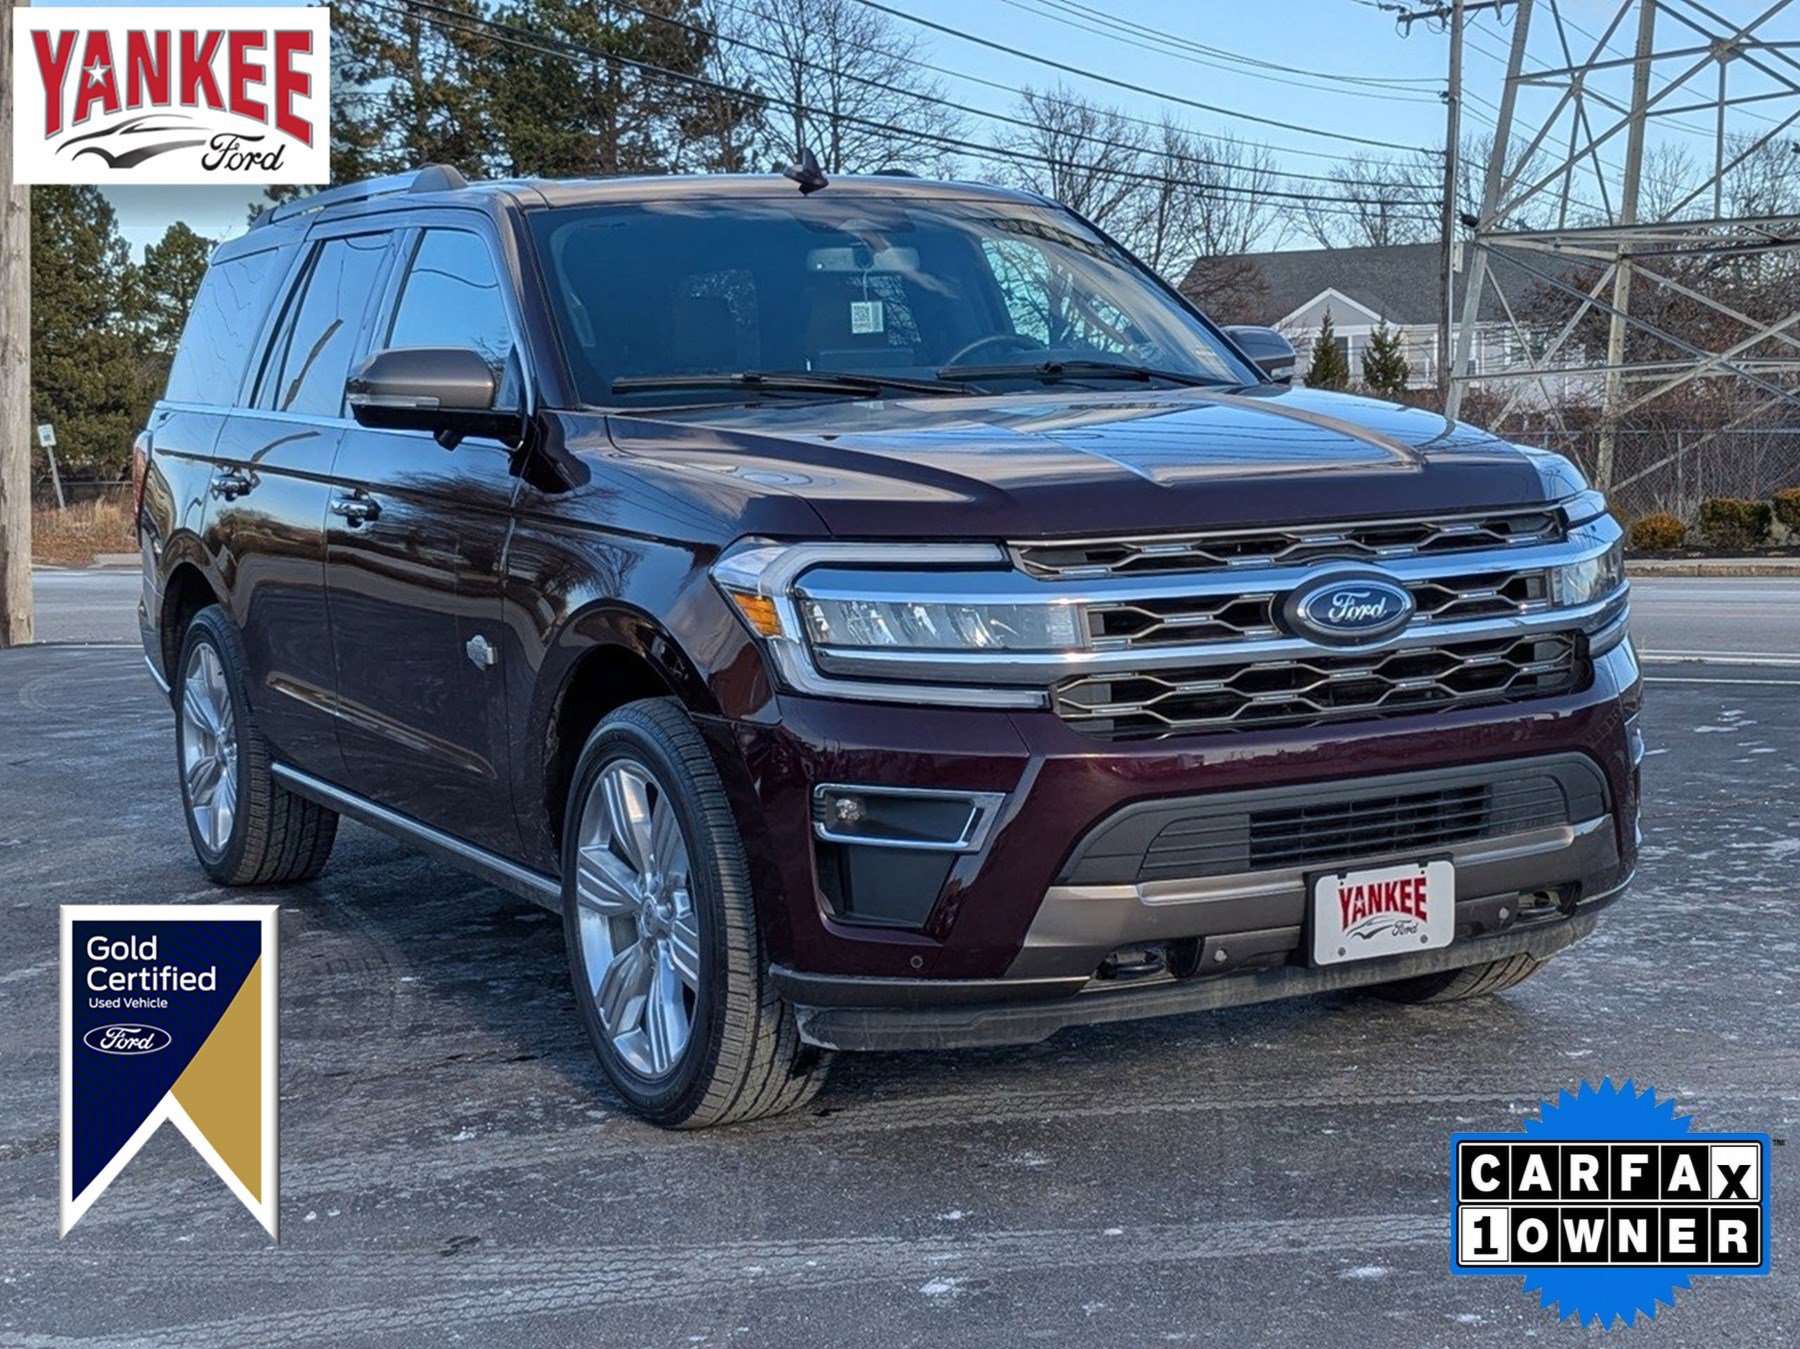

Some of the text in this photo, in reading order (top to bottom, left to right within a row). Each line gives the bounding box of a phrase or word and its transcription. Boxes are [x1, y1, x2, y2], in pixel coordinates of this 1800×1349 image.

[1327, 591, 1388, 623] Ford
[1337, 876, 1428, 932] YANKEE
[1391, 919, 1419, 937] Ford
